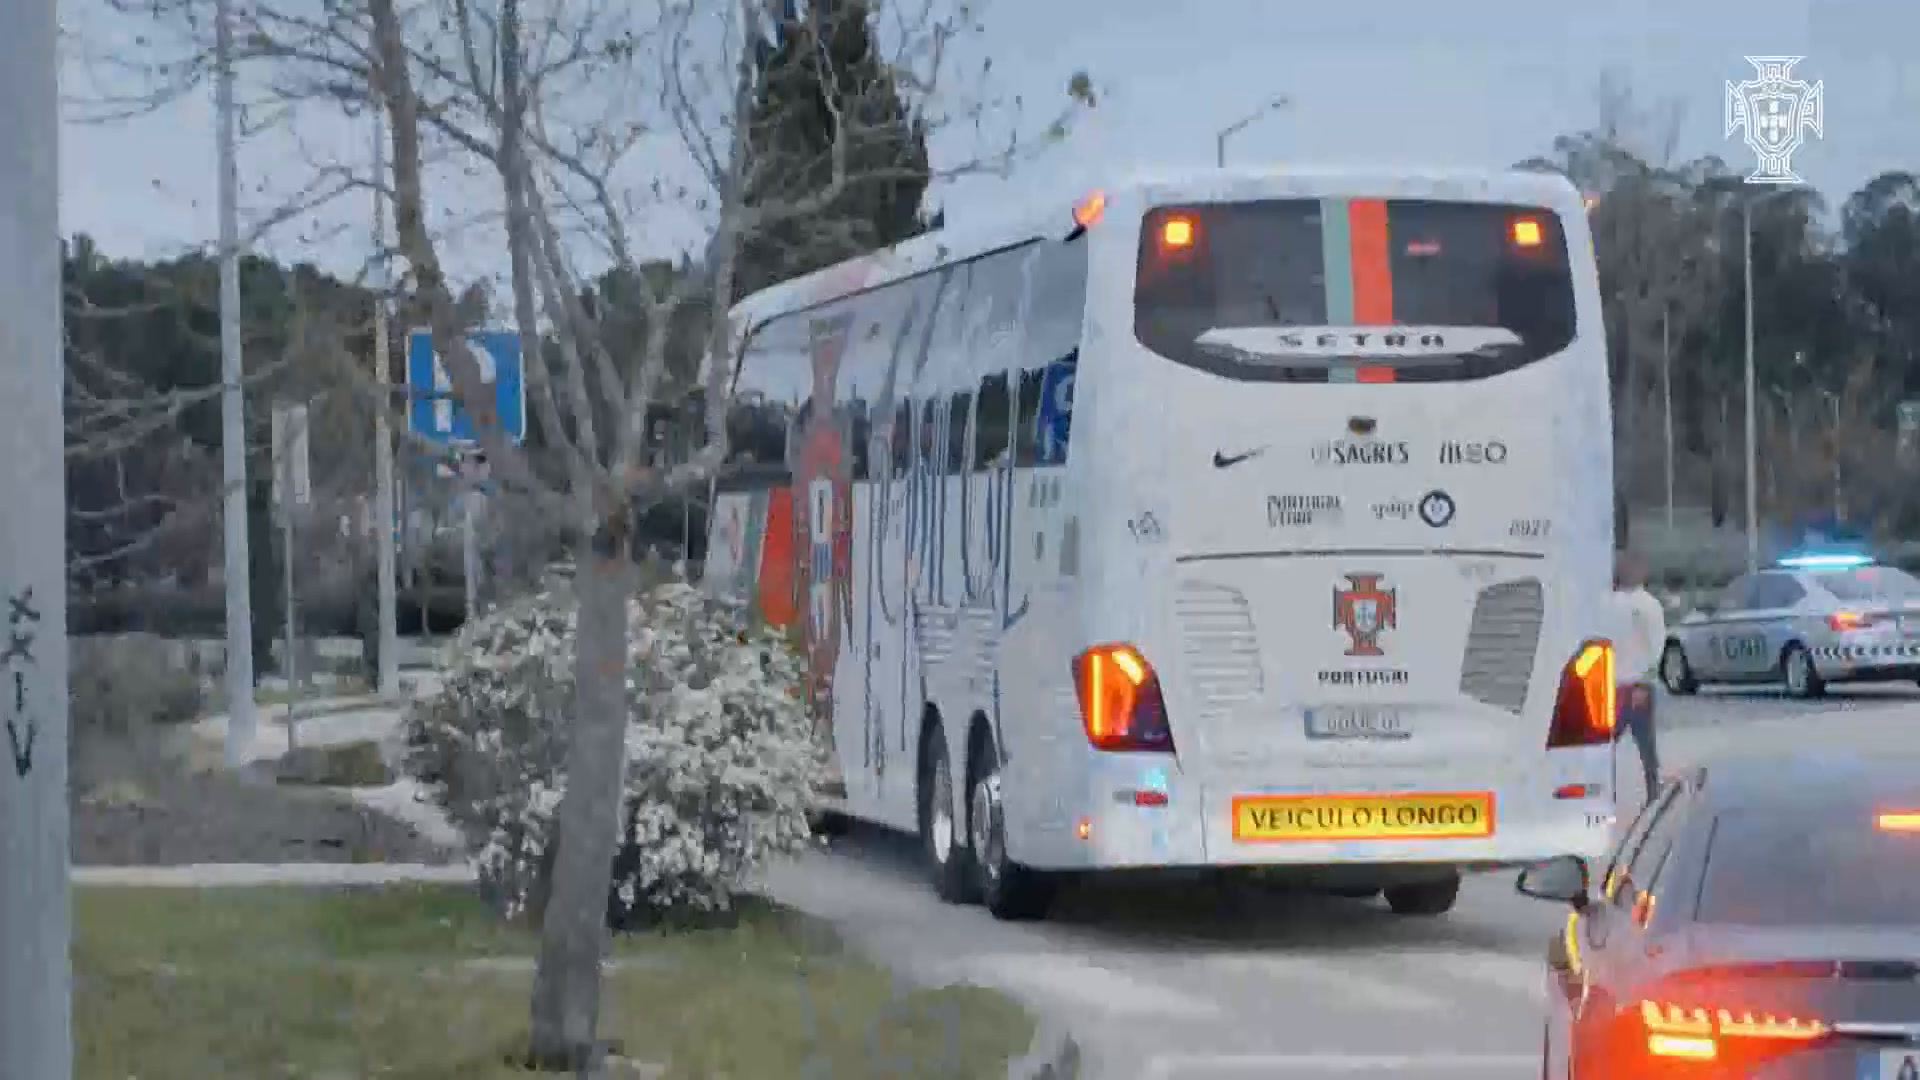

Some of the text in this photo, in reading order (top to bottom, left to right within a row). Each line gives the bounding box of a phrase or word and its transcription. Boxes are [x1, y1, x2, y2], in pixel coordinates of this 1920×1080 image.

[1278, 332, 1445, 347] SETRA
[1333, 439, 1409, 464] SAGRES
[1317, 671, 1409, 686] PORTUGAL
[1381, 804, 1477, 826] LONGO
